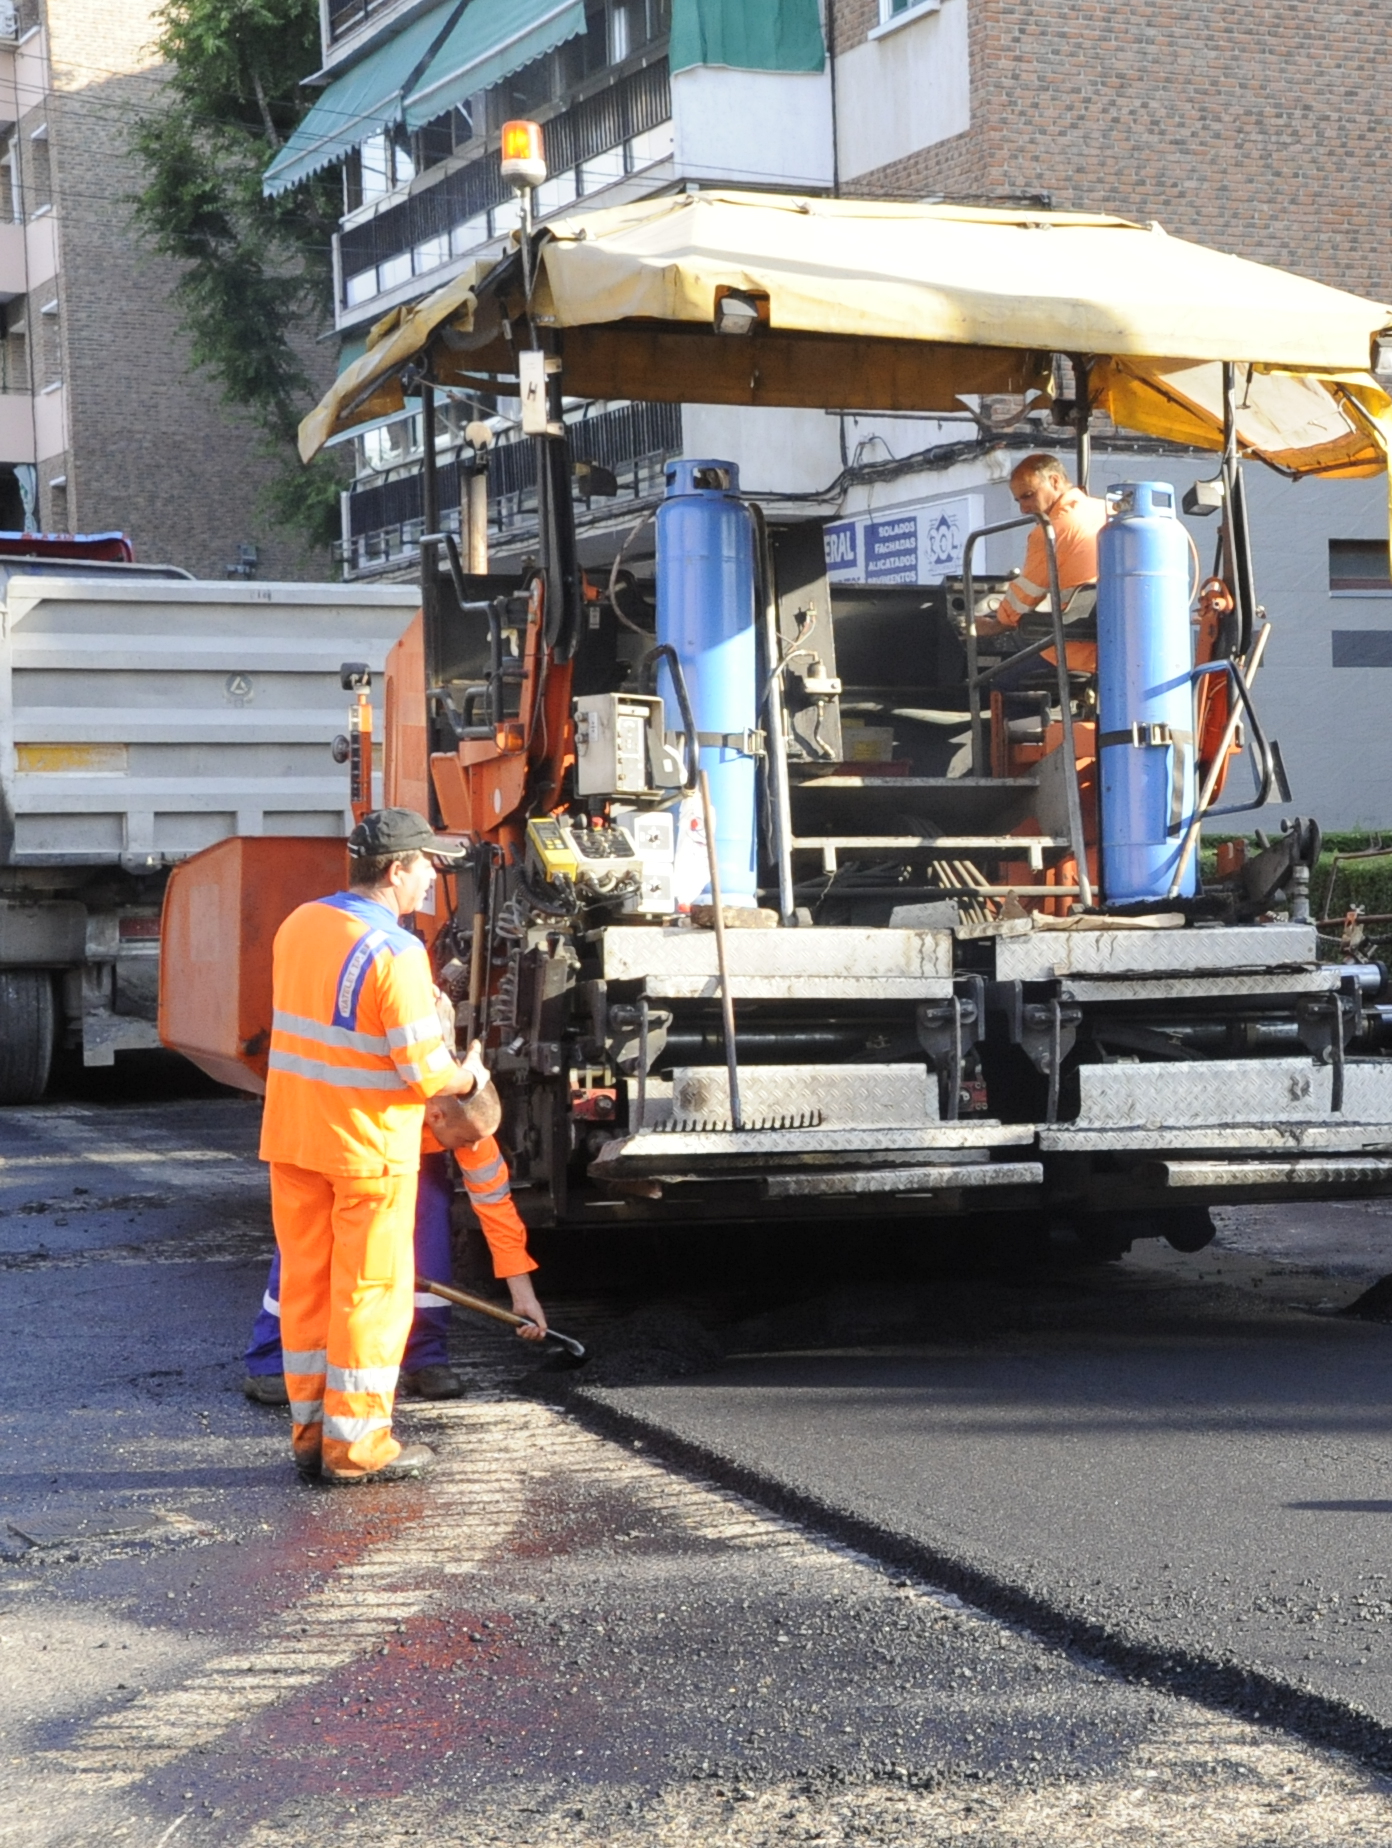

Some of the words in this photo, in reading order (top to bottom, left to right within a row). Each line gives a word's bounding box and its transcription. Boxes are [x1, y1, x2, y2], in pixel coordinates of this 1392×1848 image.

[879, 521, 915, 537] SOLADOS
[874, 537, 916, 555] FACHADAS
[868, 553, 916, 572] ALICATADOS
